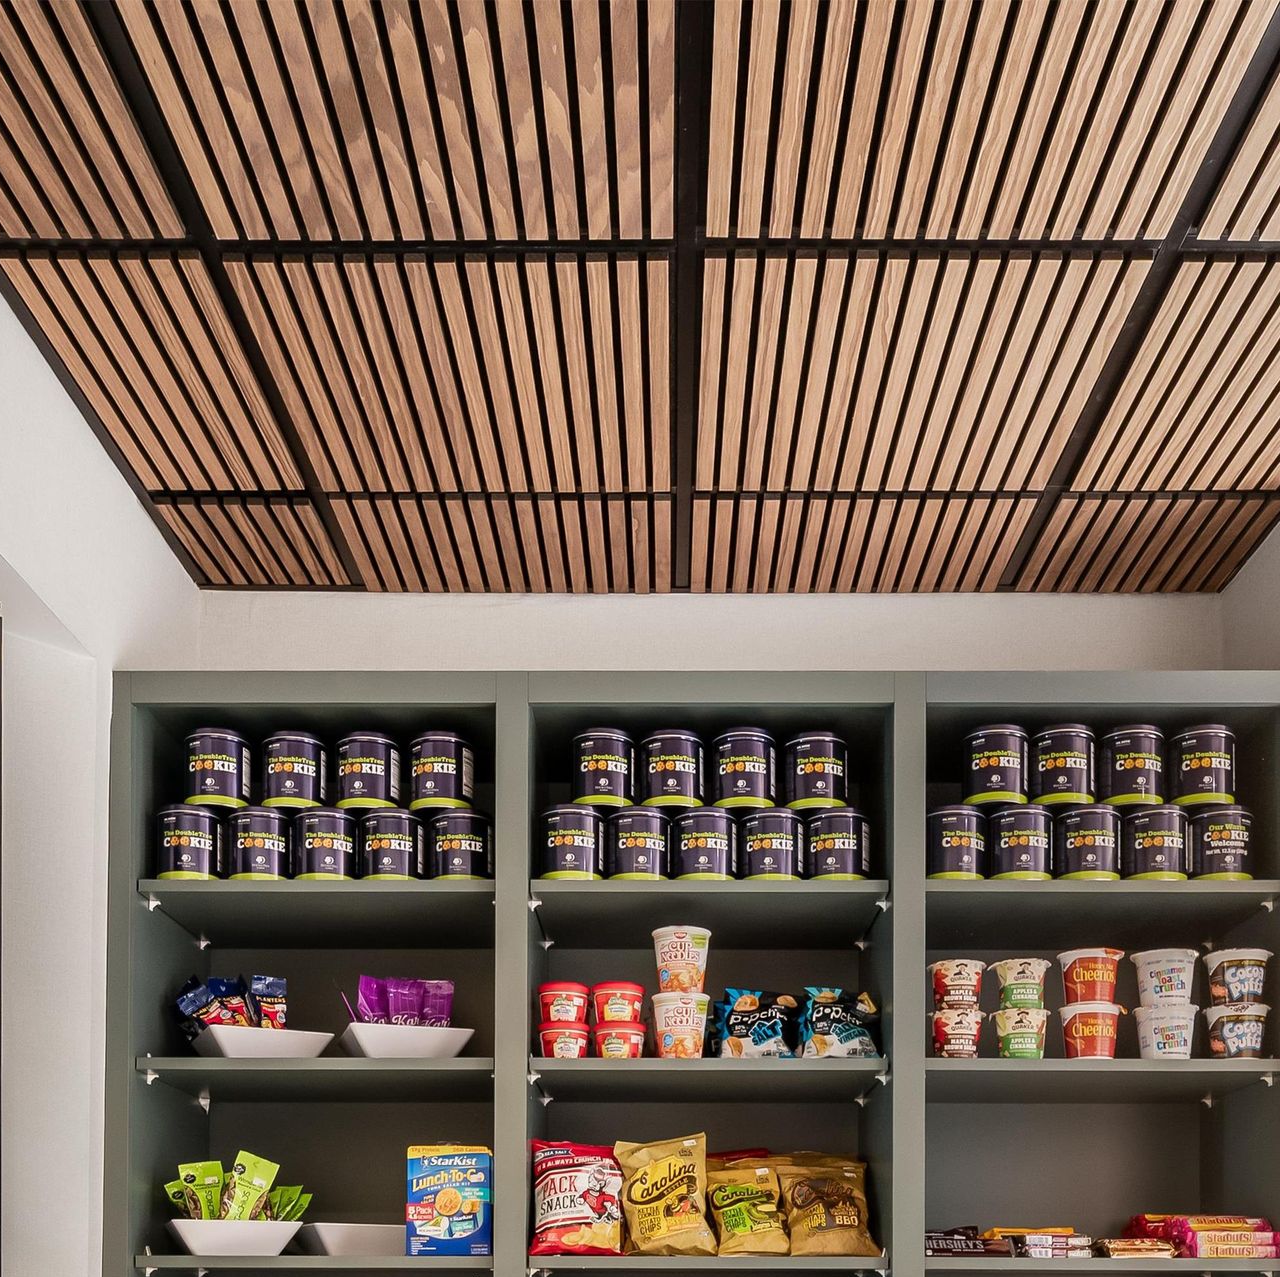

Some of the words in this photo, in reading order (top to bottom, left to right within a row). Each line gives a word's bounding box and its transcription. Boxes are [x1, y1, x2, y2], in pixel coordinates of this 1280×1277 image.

[198, 753, 237, 763] DoubleTree
[189, 760, 238, 774] COOKIE
[268, 762, 316, 776] COOKIE
[164, 836, 213, 851] COOKIE
[436, 839, 483, 852] COOKIE
[668, 941, 693, 951] CUP
[661, 951, 700, 963] NOODLES
[1073, 969, 1115, 983] Cheerios
[1150, 967, 1186, 979] Cinnamon
[1157, 974, 1181, 984] Toast
[1225, 965, 1264, 983] Cocoa
[1154, 982, 1186, 994] Crunch
[1229, 977, 1263, 1000] Puffs
[673, 1007, 698, 1017] CUP
[665, 1016, 702, 1028] NOODLES
[1072, 1023, 1115, 1037] Cheerios
[1153, 1024, 1189, 1035] Cinnamon
[1223, 1021, 1263, 1038] Cocoa
[1157, 1038, 1188, 1050] Crunch
[1227, 1032, 1261, 1056] Puffs
[430, 1156, 477, 1167] StarKist
[542, 1175, 578, 1200] PACK
[627, 1163, 697, 1204] Carolina
[540, 1194, 577, 1216] SNACK
[835, 1216, 858, 1226] BBQ
[639, 1223, 661, 1235] CHIPS
[925, 1239, 984, 1249] HERSHEY'S
